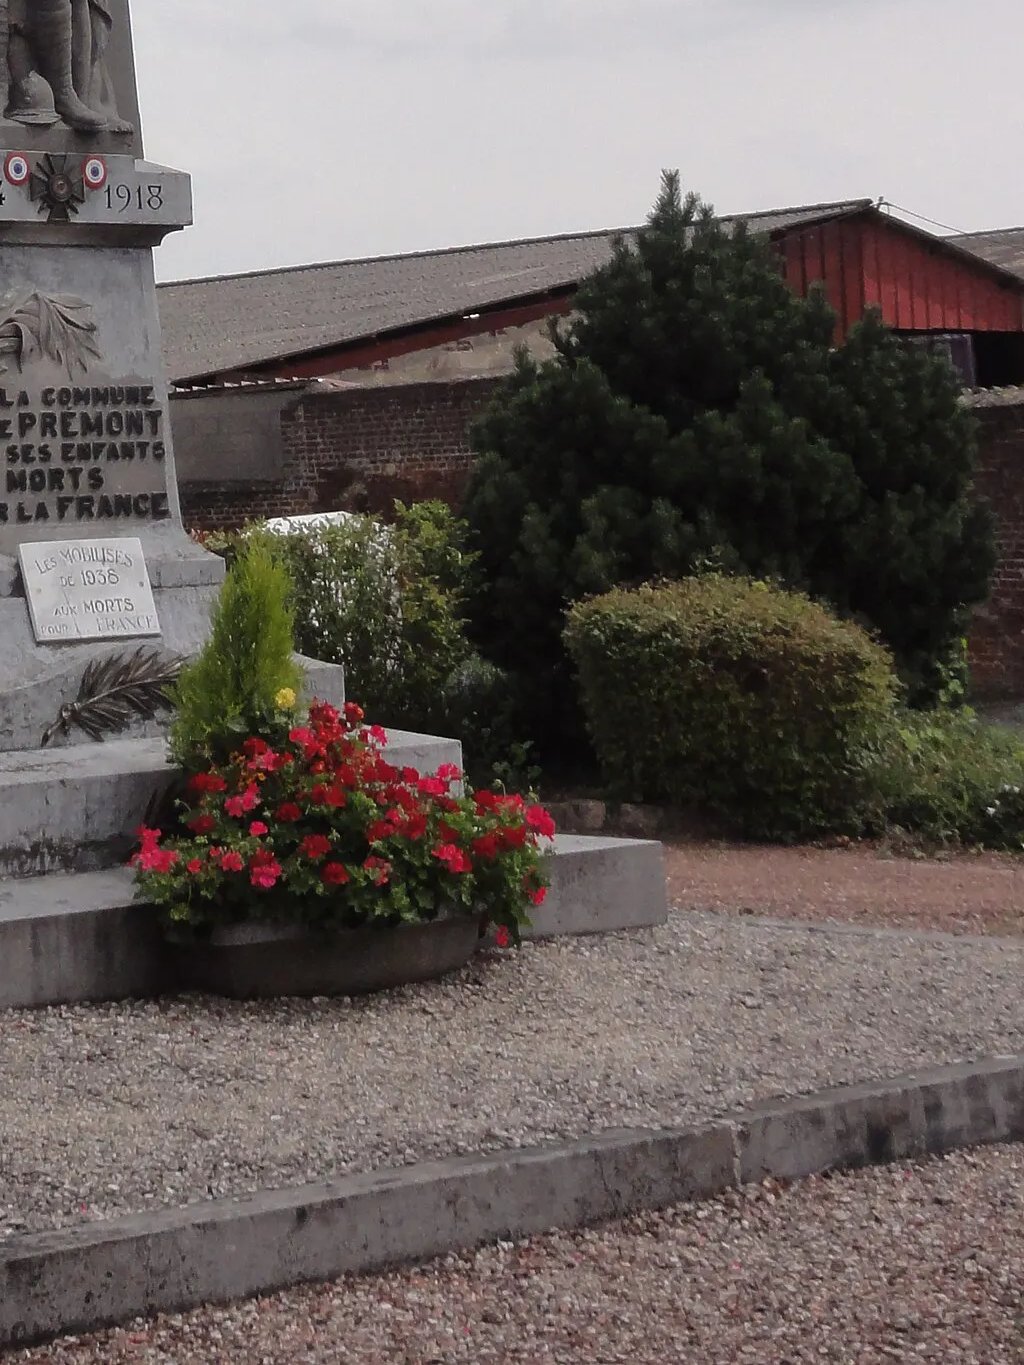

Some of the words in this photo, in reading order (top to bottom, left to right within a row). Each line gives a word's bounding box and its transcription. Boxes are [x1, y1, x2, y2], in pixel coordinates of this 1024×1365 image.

[104, 184, 164, 214] 1918
[40, 386, 155, 407] COMMUNE
[5, 444, 52, 463] SES
[60, 441, 166, 461] ENFANTS
[6, 466, 105, 493] MORTS
[17, 501, 51, 522] LA
[56, 492, 171, 522] FRANCE
[34, 556, 58, 575] LES
[60, 575, 75, 588] DE
[83, 597, 136, 615] MORTS
[96, 614, 154, 633] FRANCE
